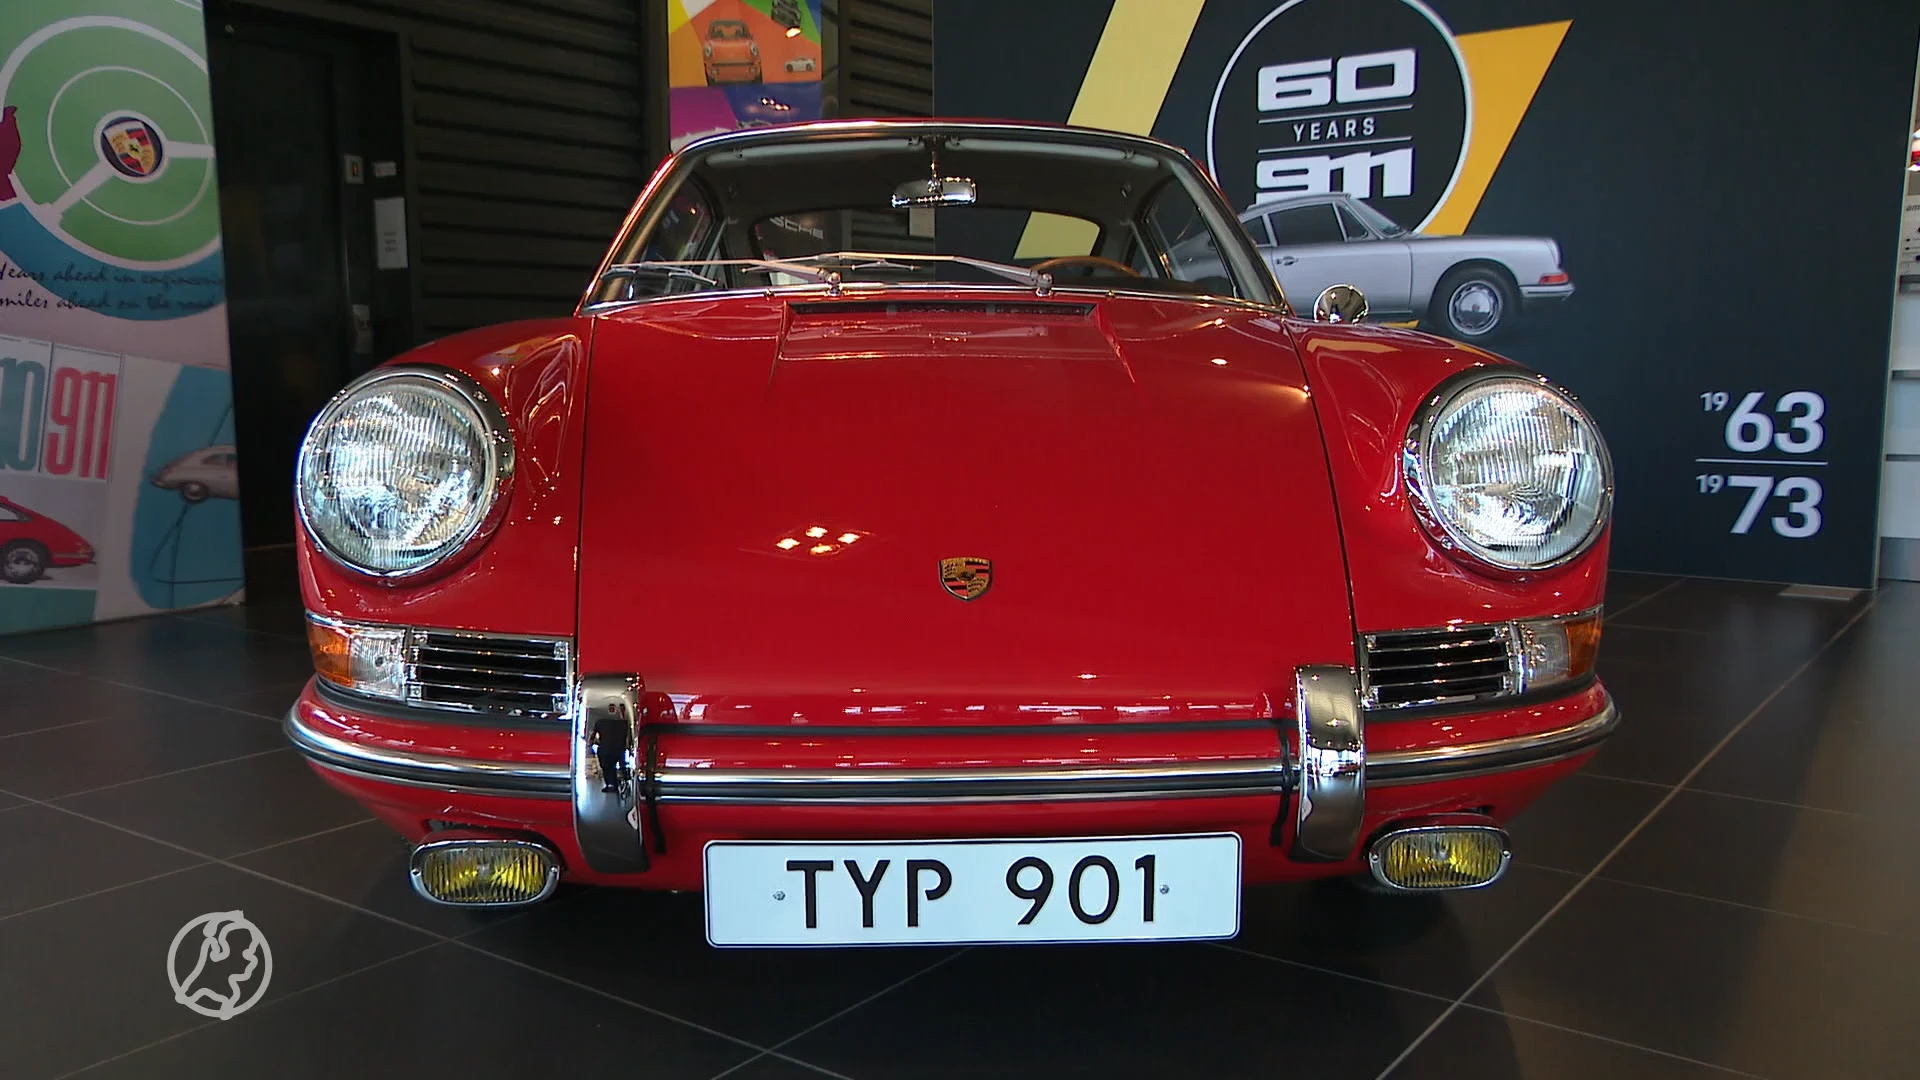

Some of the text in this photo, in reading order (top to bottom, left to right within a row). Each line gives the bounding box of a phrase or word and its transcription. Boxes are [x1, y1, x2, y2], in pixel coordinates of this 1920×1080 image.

[1257, 48, 1417, 112] 60
[1293, 117, 1377, 142] YEARS
[1256, 147, 1415, 204] 911
[45, 366, 117, 480] 911
[786, 854, 1156, 929] TYP 901
